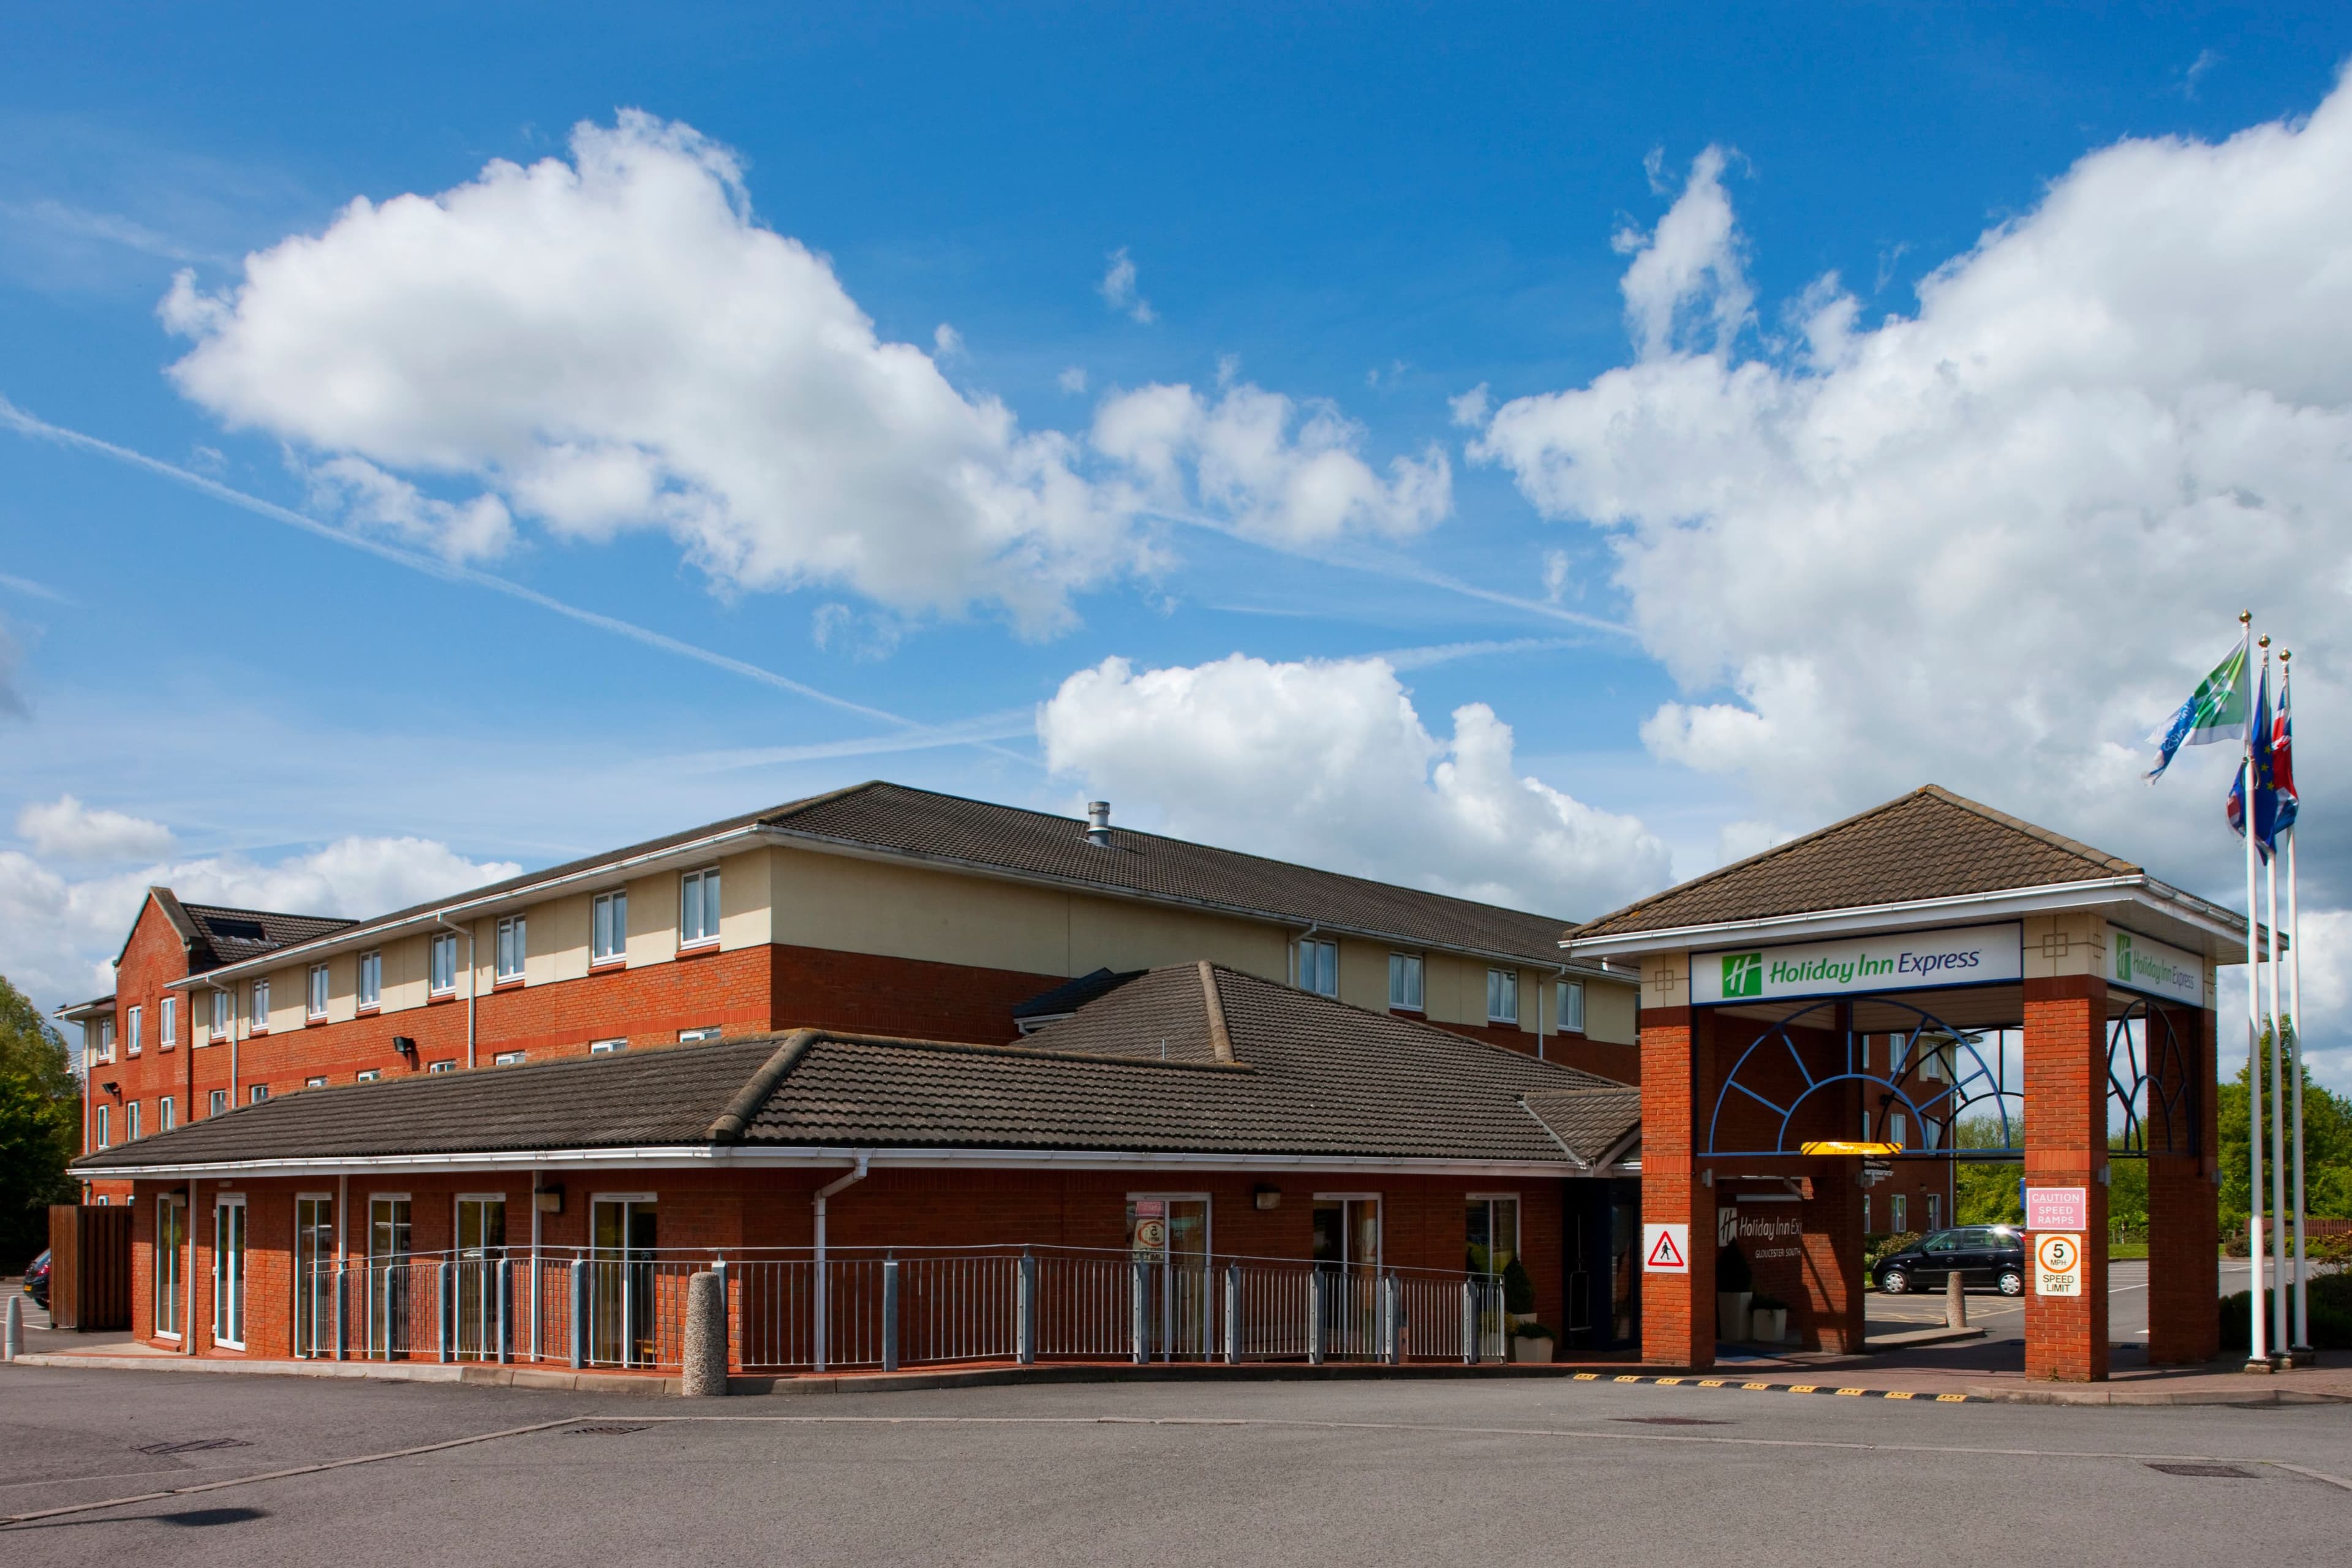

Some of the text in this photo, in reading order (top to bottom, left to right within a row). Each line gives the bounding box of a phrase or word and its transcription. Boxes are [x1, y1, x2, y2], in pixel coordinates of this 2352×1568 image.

[1768, 957, 1854, 983] Holiday
[1858, 954, 1893, 976] Inn
[1898, 951, 1980, 976] Express
[2133, 950, 2160, 985] Holiday
[2161, 959, 2172, 981] Inn
[2172, 966, 2195, 992] Express
[1740, 1216, 1775, 1240] Holiday
[1776, 1216, 1790, 1235] Inn
[1755, 1248, 1801, 1258] GLOUCESTER SOUTH
[2052, 1243, 2064, 1258] 5
[2043, 1275, 2074, 1283] SPEED
